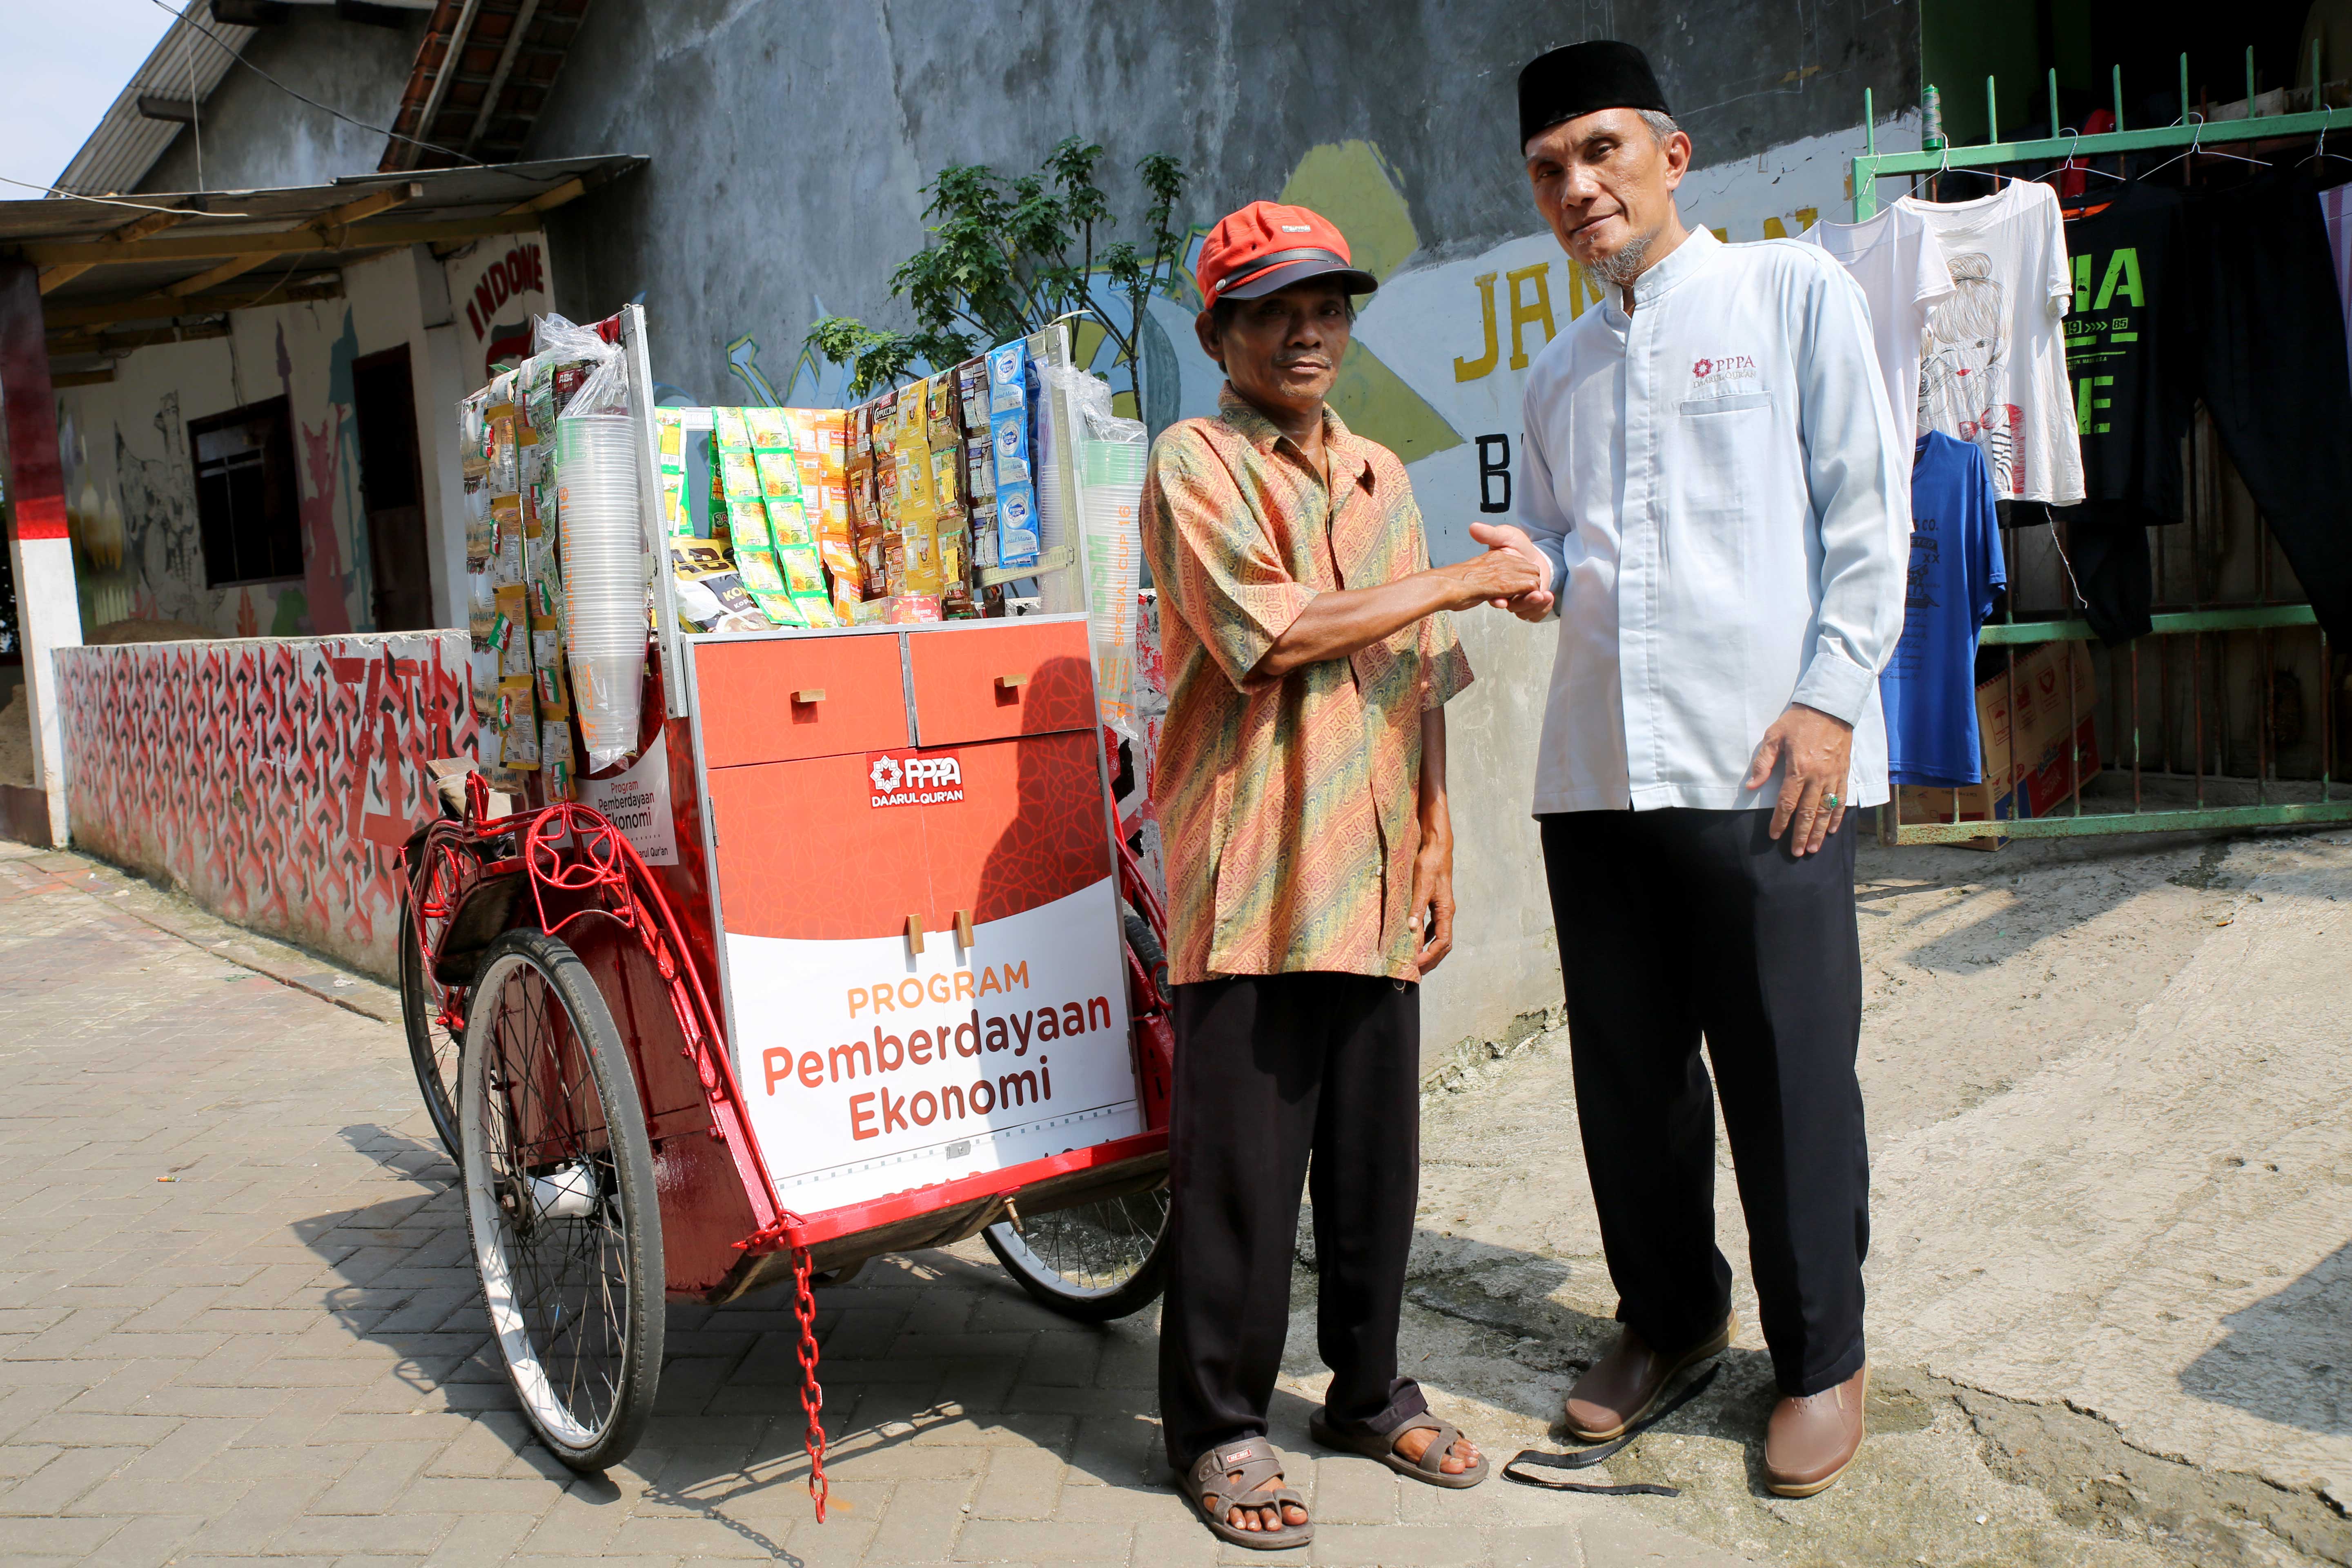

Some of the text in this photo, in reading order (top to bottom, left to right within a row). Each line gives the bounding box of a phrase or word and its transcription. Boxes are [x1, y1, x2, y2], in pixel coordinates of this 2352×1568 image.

[2069, 247, 2145, 312] IA
[2113, 318, 2128, 329] 85
[1716, 355, 1755, 372] PPPA
[559, 372, 574, 383] ABC
[1693, 369, 1756, 388] DAARUL QUR'AN
[874, 405, 897, 423] CAPPUCCINO
[1476, 434, 1524, 513] B
[715, 514, 728, 525] JA
[1922, 519, 1939, 531] CO.
[1911, 539, 1934, 548] ETED
[559, 487, 575, 652] SPESIAL CUP 16
[1114, 505, 1131, 647] SPESIAL CUP 16
[904, 757, 962, 789] PPPA
[610, 780, 639, 794] Program
[598, 792, 655, 812] Pemberdayaan
[871, 790, 963, 807] DAARUL QUR'AN
[650, 846, 668, 857] Qur'an
[847, 960, 1029, 1019] PROGRAM
[763, 996, 1111, 1096] Pemberdayaan
[849, 1055, 1051, 1140] Ekonomi
